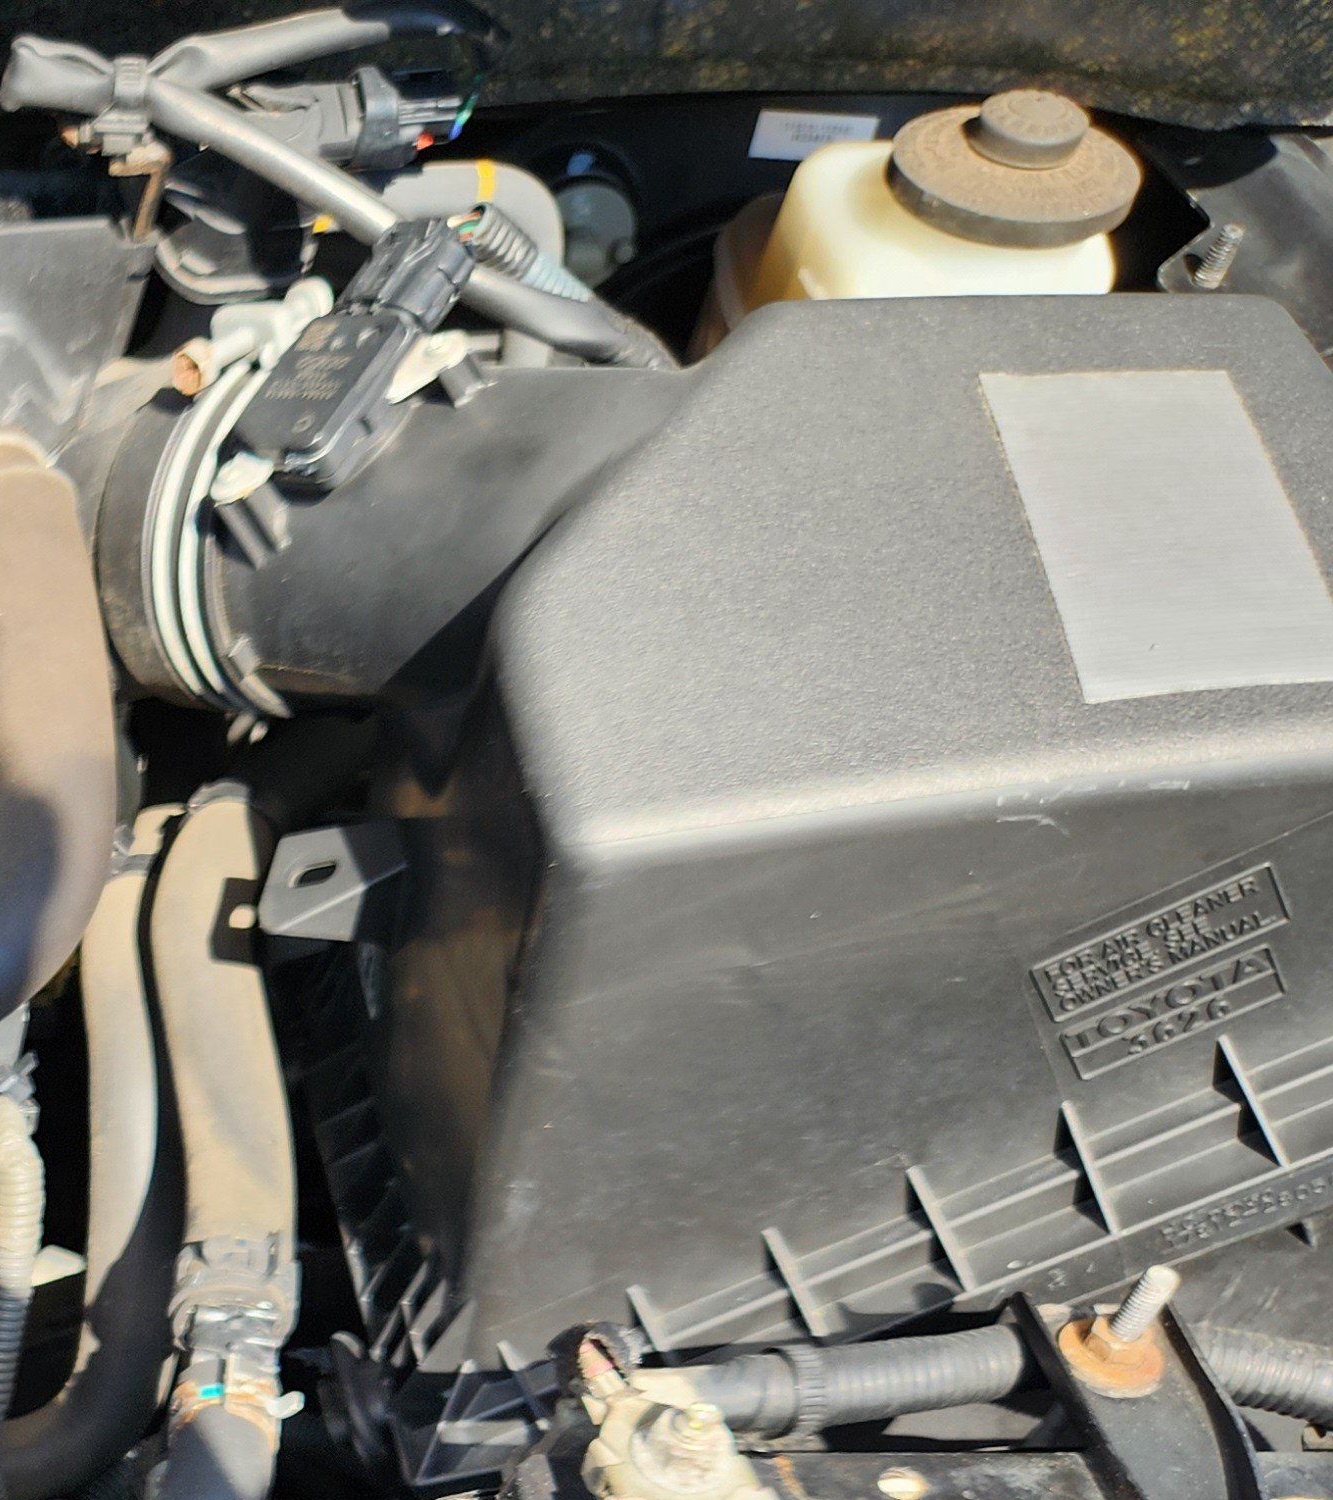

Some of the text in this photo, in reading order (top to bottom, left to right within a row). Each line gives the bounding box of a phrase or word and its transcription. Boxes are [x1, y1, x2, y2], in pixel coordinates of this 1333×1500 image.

[1044, 876, 1260, 983] FOR AIR CLEANER
[1060, 911, 1277, 1012] OWNER'S MANUAL.
[1164, 914, 1211, 949] SEE
[1064, 957, 1270, 1049] TOYOTA
[1122, 997, 1231, 1055] 3626
